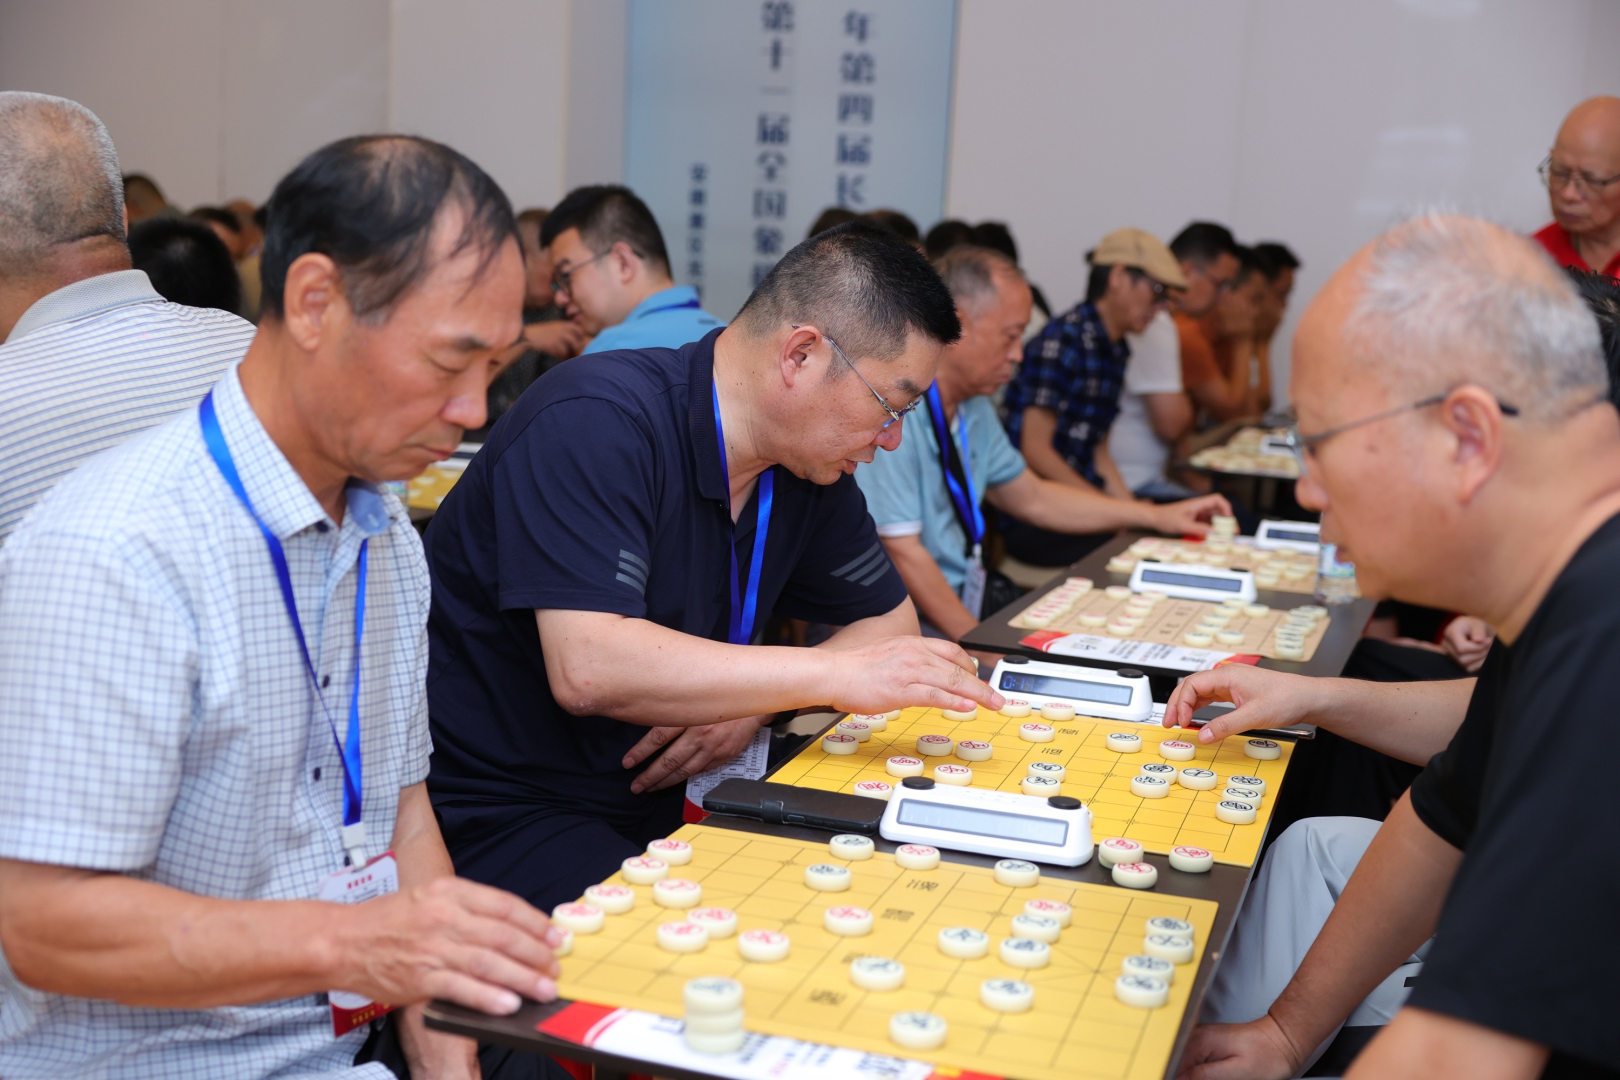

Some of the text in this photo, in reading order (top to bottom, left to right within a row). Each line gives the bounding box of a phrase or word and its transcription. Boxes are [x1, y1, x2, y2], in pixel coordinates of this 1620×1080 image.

[751, 1, 795, 288] 第十一届全国象
